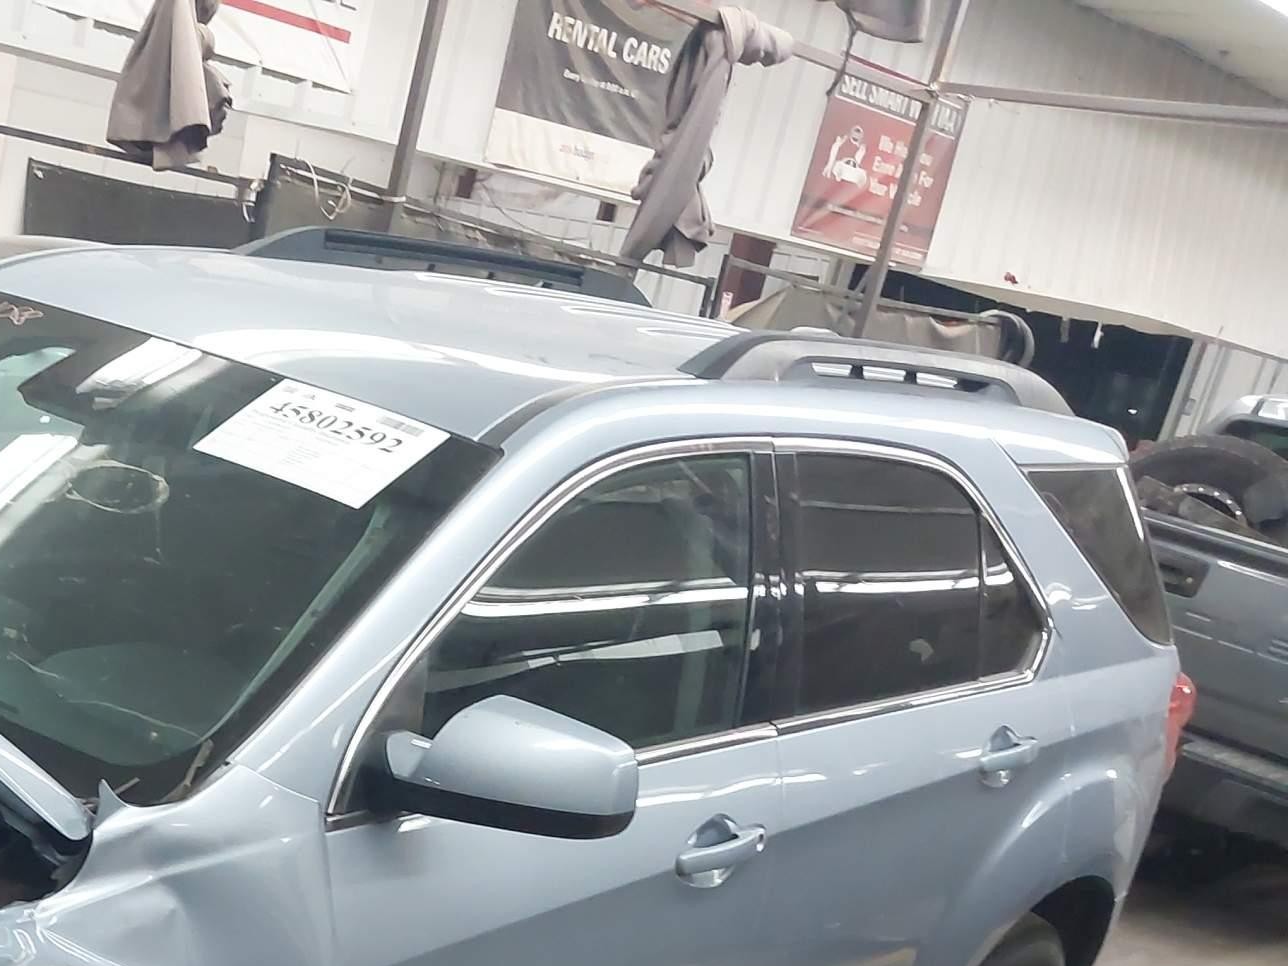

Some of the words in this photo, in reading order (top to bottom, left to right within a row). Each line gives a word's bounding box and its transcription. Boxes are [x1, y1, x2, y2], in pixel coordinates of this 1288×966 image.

[547, 12, 618, 58] RENTAL
[622, 37, 672, 75] CARS
[269, 402, 404, 453] 45802592
